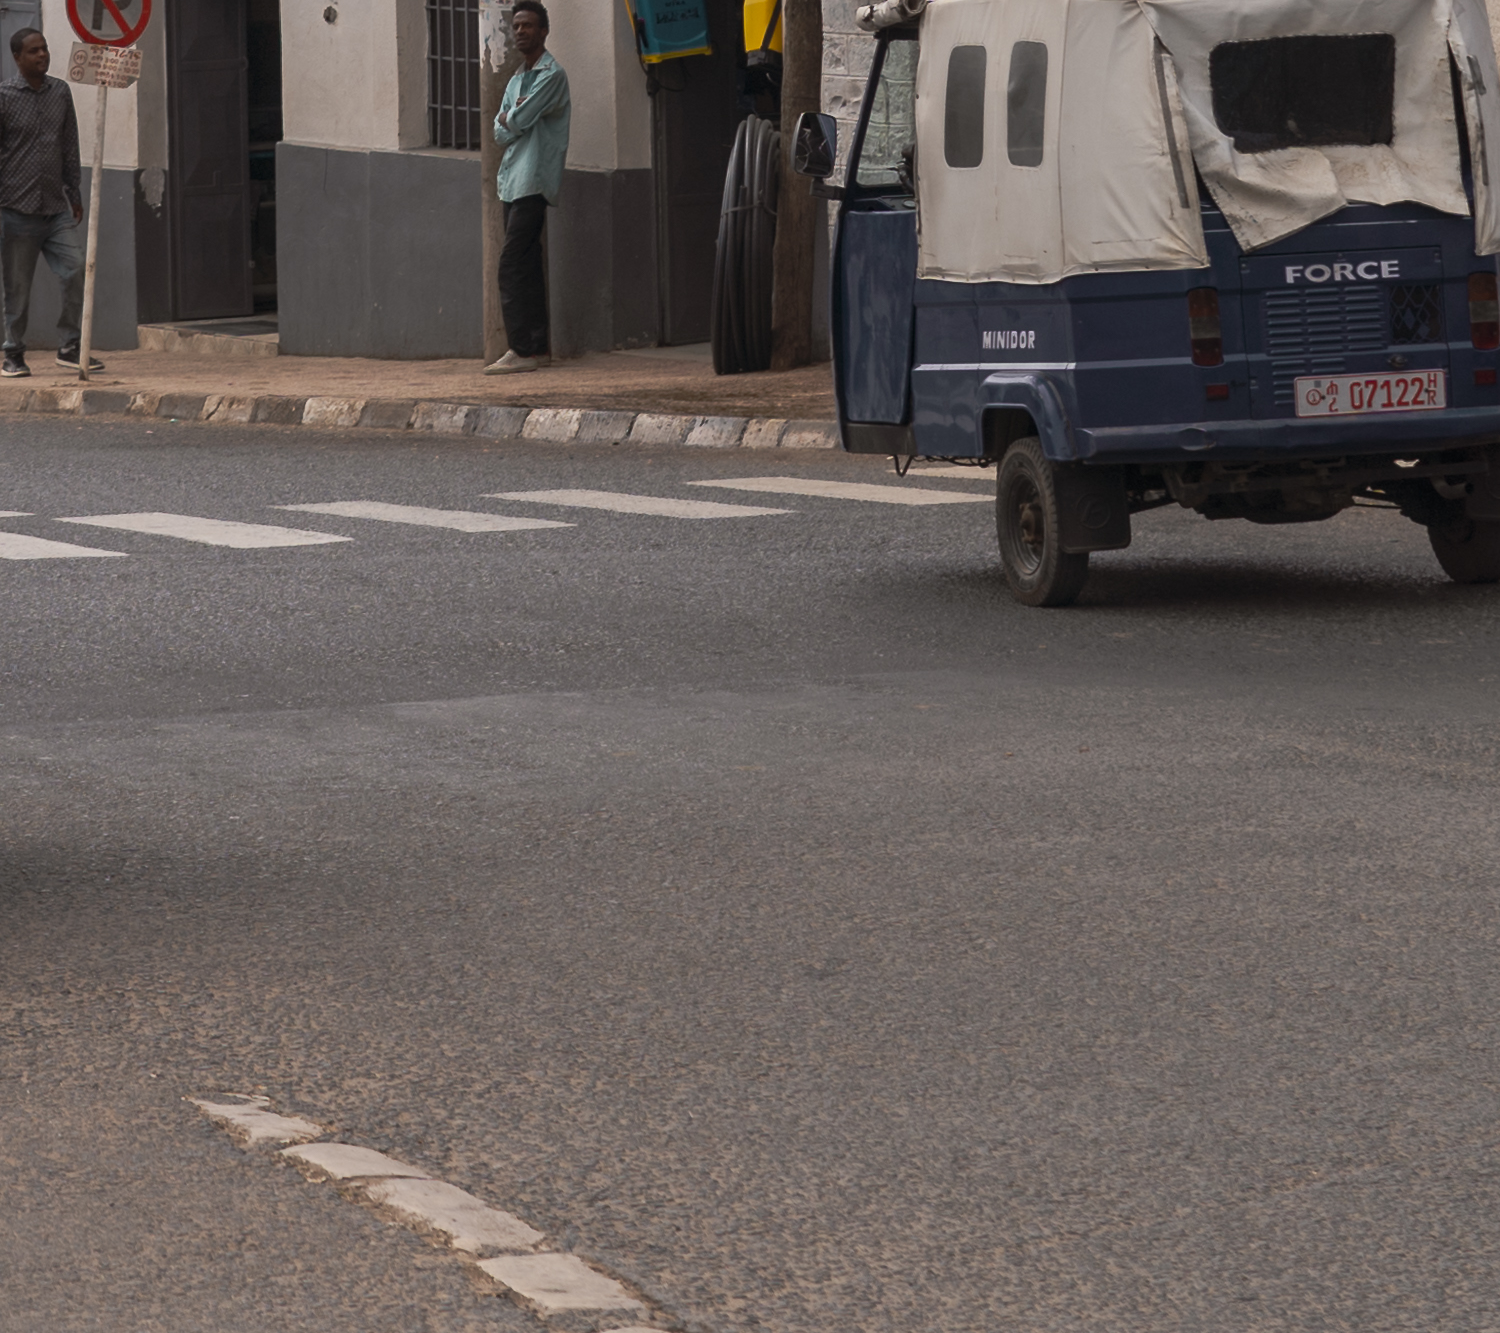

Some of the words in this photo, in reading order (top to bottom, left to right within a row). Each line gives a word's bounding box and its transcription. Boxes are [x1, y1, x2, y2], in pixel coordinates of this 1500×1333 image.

[1286, 259, 1400, 284] FORCE
[982, 329, 1036, 350] MINIDOR
[1350, 377, 1425, 410] 07122
